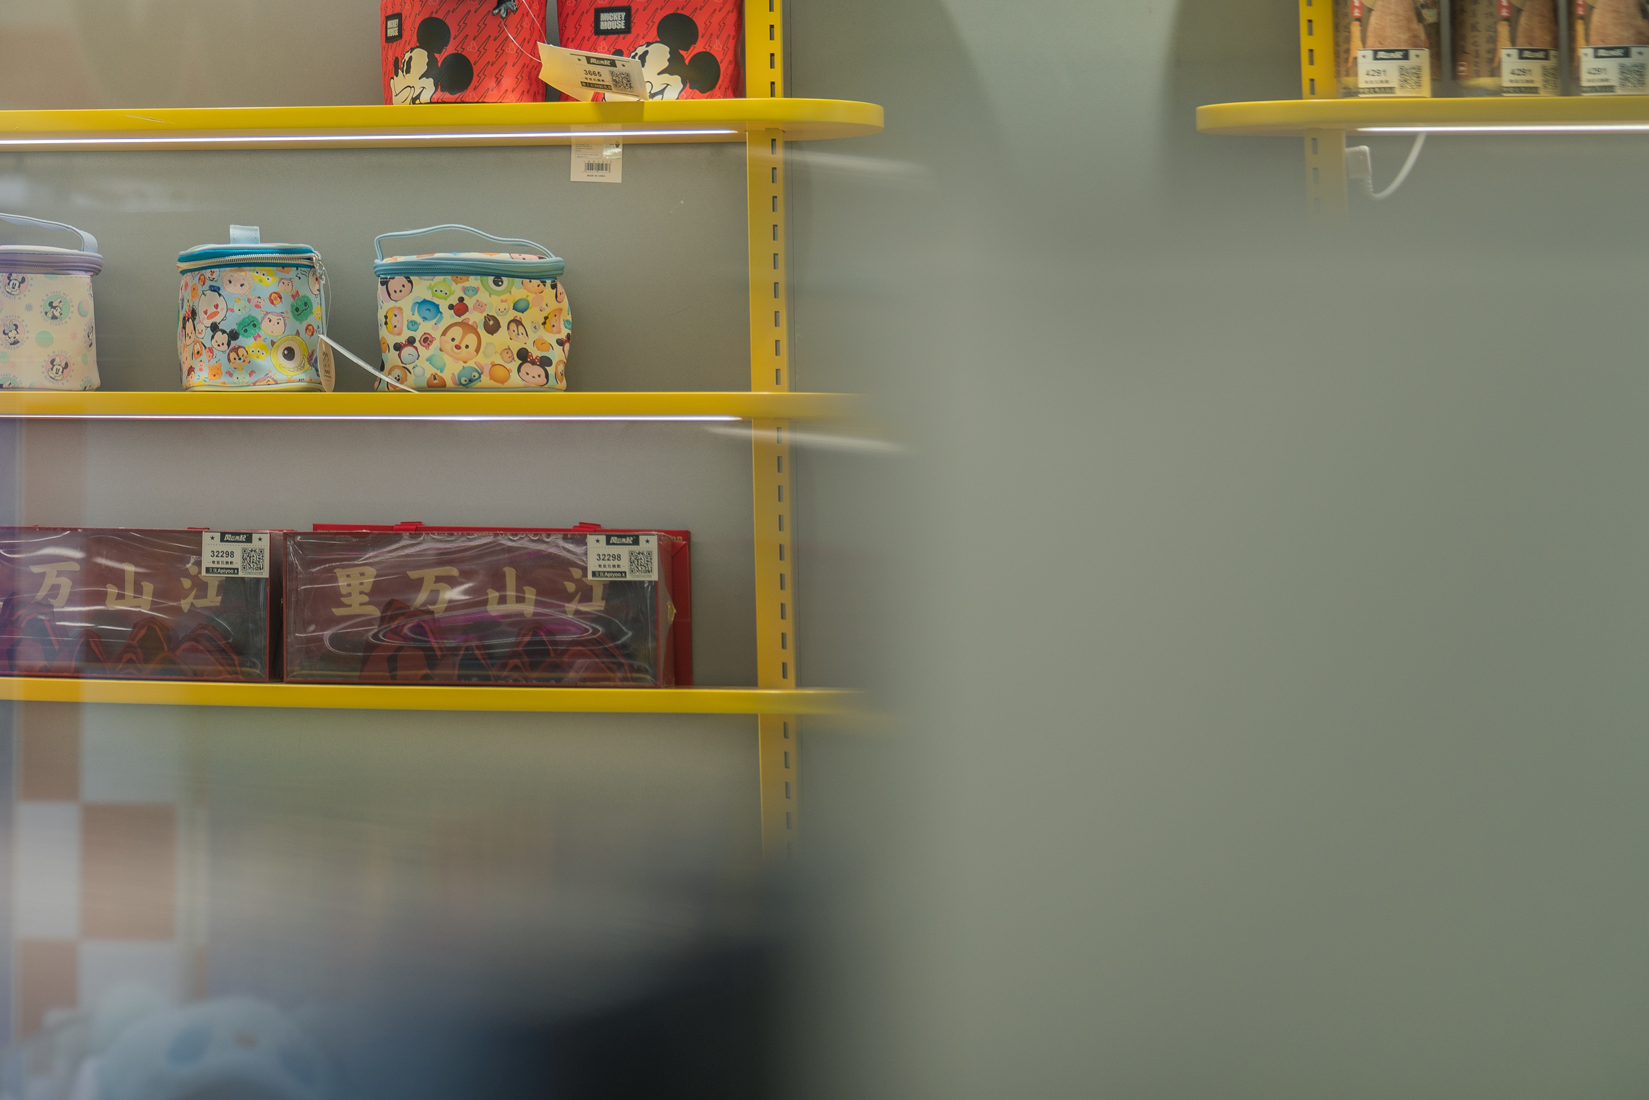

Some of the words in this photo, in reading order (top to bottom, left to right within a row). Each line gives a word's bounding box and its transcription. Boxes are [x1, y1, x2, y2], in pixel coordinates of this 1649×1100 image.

[600, 12, 626, 21] MICKEY
[600, 20, 626, 30] MOUSE
[211, 550, 235, 558] 32298
[596, 554, 622, 562] 32298
